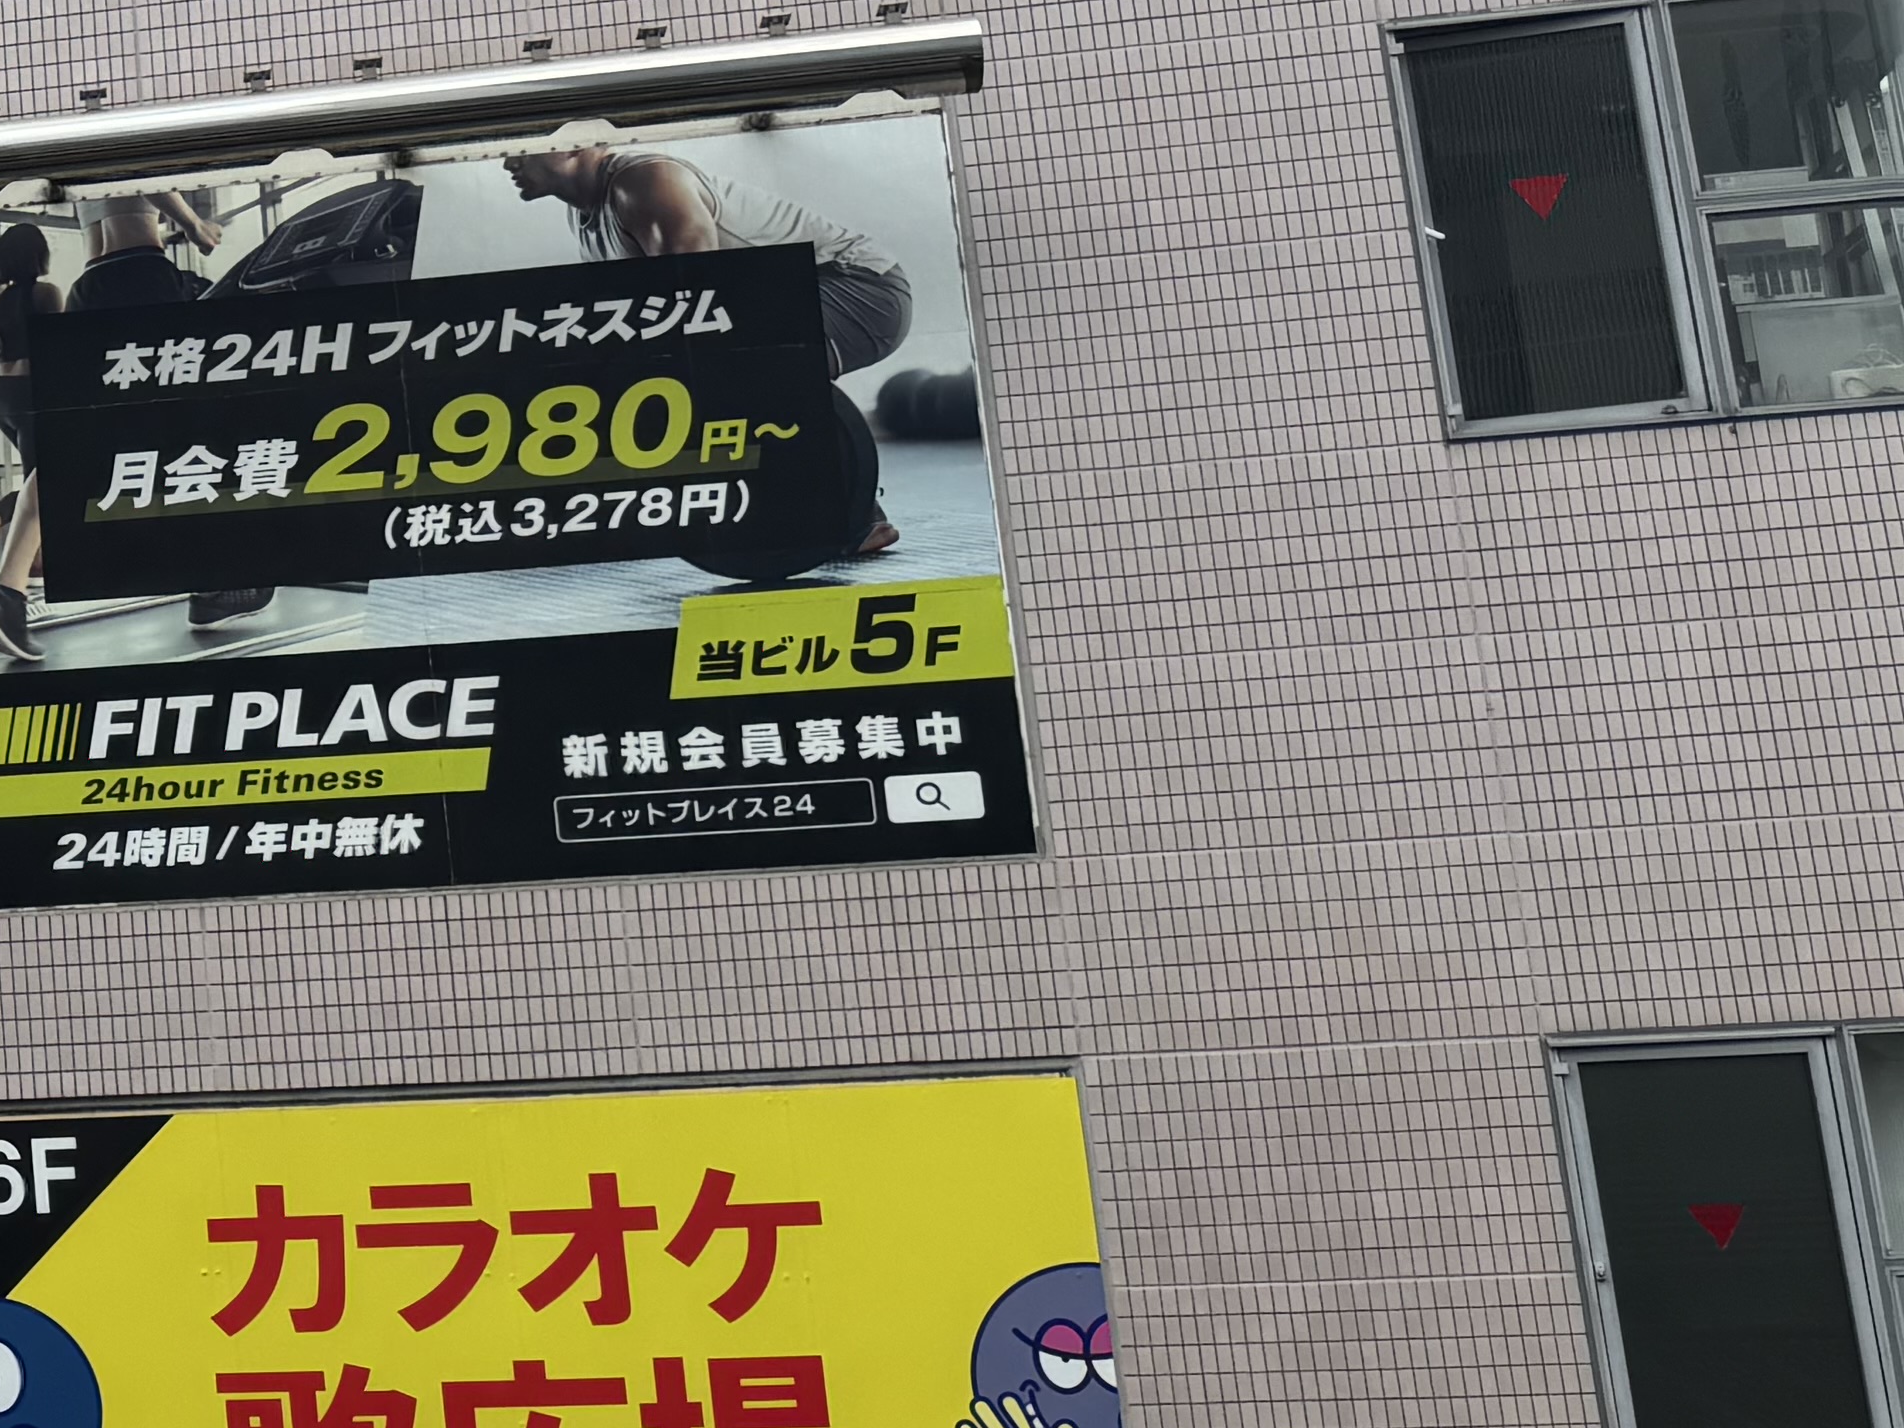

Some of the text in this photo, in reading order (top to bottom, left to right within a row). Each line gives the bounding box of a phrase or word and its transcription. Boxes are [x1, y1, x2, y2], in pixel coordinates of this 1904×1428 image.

[88, 675, 499, 761] FIT PLACE
[562, 712, 962, 779] 新規会員募集中
[80, 762, 383, 806] 24hour Fitness
[206, 1167, 822, 1338] カラオケ
